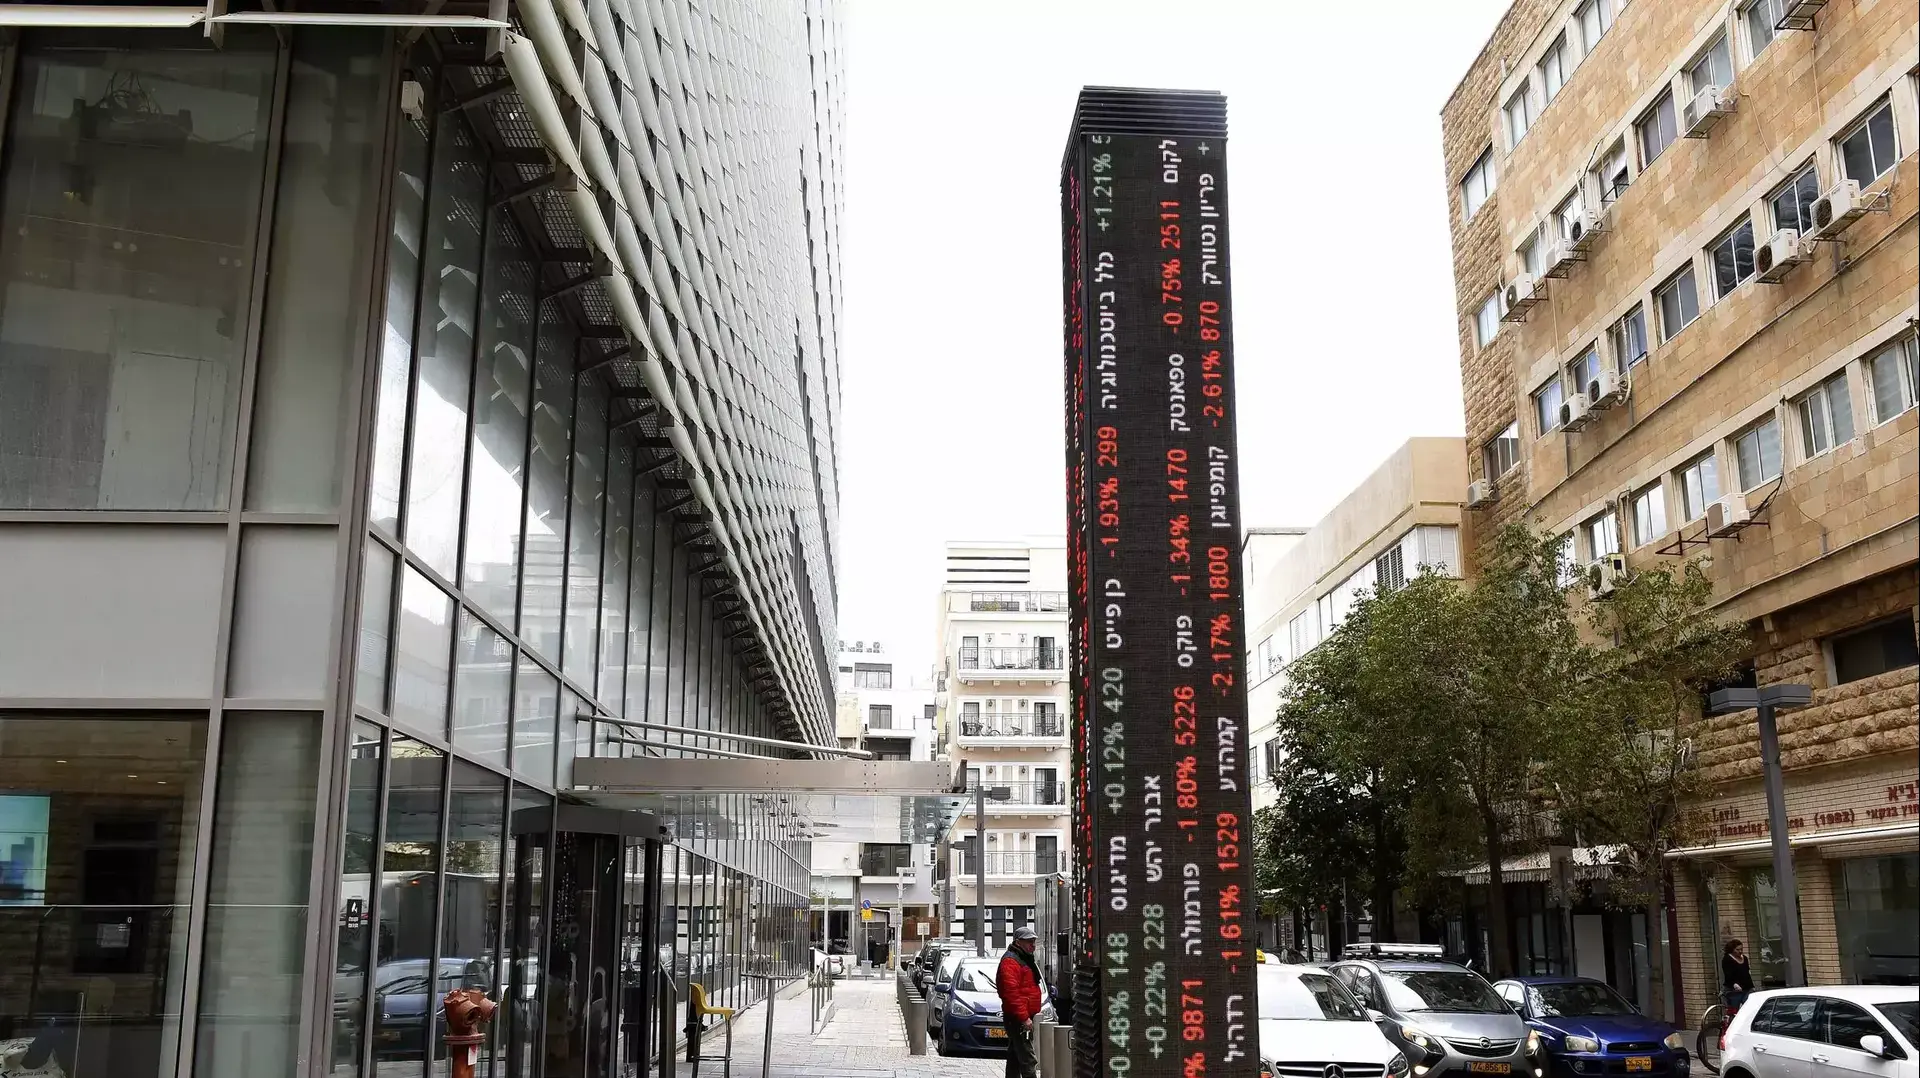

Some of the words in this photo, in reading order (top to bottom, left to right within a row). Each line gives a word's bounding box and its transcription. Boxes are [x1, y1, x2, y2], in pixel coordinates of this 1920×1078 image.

[1158, 139, 1182, 184] לקום
[1092, 153, 1113, 232] +1.21%
[1199, 173, 1220, 218] פריון
[1160, 201, 1181, 249] 2511
[1094, 251, 1115, 283] כלל
[1161, 258, 1183, 334] -0.75%
[1096, 290, 1118, 409] ביוטכנולוגיה
[1199, 300, 1221, 341] 870
[1168, 353, 1191, 432] ספאנטק
[1201, 350, 1224, 428] -2.61%
[1097, 426, 1118, 467] 299
[1166, 448, 1189, 503] 1470
[1098, 477, 1119, 558] -1.93%
[1169, 514, 1191, 596] -1.34%
[1207, 546, 1230, 601] 1800
[1105, 603, 1123, 649] פייט
[1176, 615, 1198, 668] פוקס
[1210, 613, 1233, 697] -2.17%
[1101, 667, 1124, 713] 420
[1173, 686, 1196, 746] 5226
[1102, 721, 1126, 815] +0.12%
[1217, 716, 1239, 792] קמהדע
[1144, 774, 1162, 832] אבנר
[1176, 755, 1199, 842] -1.80%
[1145, 840, 1163, 882] יהש
[1216, 812, 1239, 871] 1529
[1109, 835, 1128, 912] מדיגוס
[1142, 903, 1165, 950] 228
[1180, 862, 1203, 957] פורמולה
[1219, 884, 1243, 974] -1.61%
[1106, 932, 1129, 978] 148
[1143, 961, 1167, 1060] +0.22%
[1181, 980, 1205, 1041] 9871
[1223, 995, 1245, 1063] רדהיל
